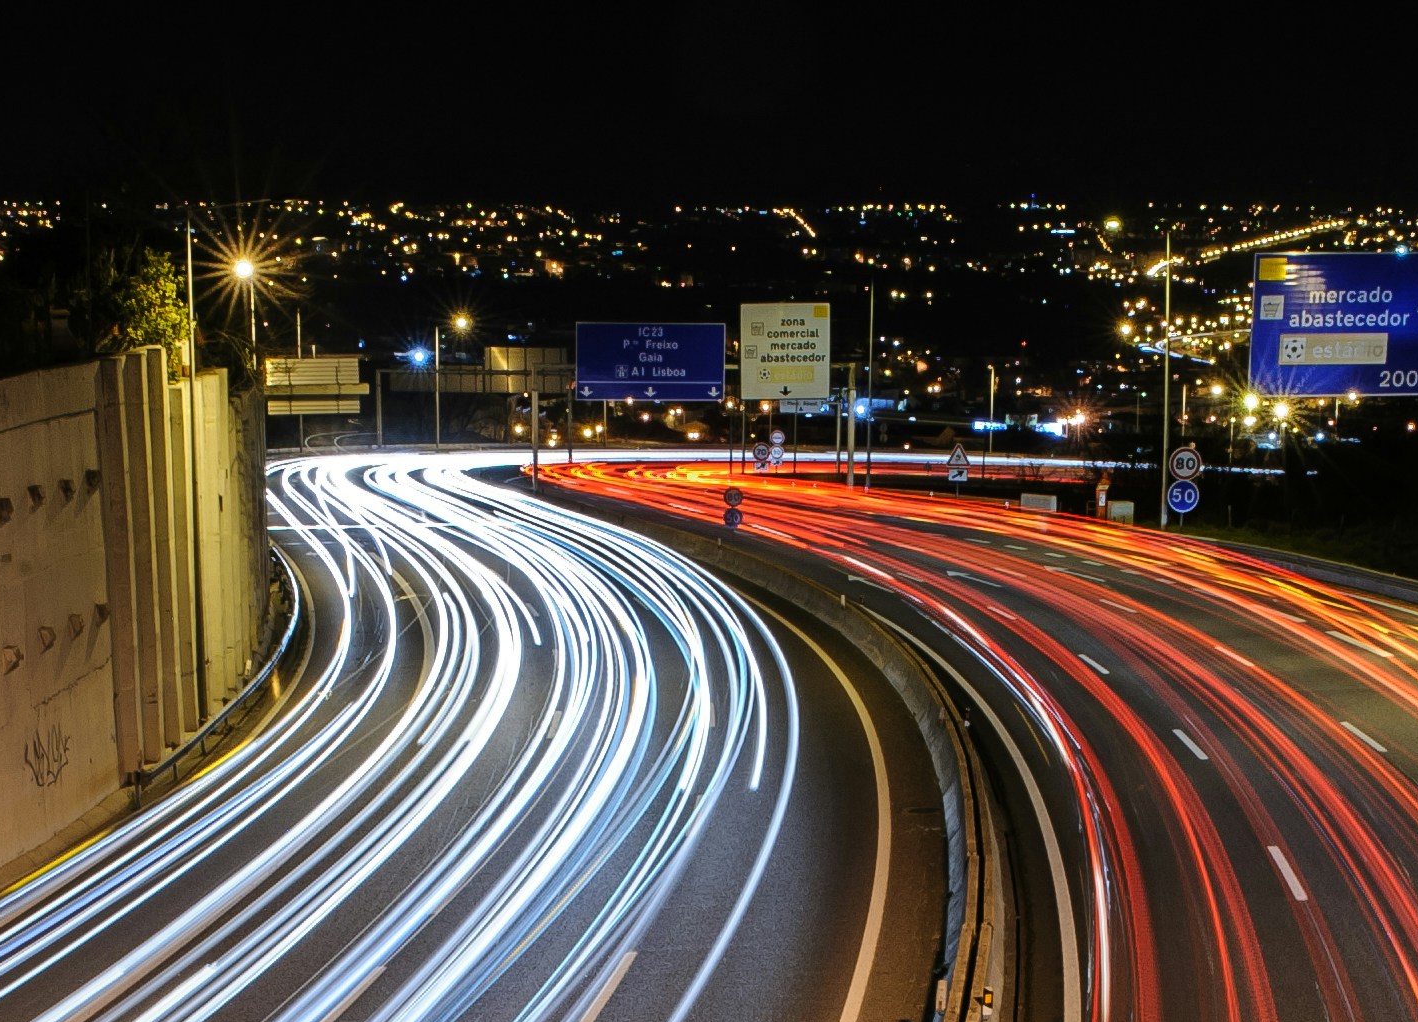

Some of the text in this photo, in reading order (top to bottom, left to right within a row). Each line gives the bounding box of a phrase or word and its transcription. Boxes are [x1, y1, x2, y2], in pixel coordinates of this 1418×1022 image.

[1309, 286, 1392, 303] mercado
[781, 319, 805, 327] zona
[1289, 310, 1410, 327] abastecedor
[638, 327, 664, 337] IC23
[767, 329, 819, 338] comercial
[645, 339, 679, 349] Freixo
[770, 341, 816, 351] mercado
[639, 352, 663, 362] Gaia
[760, 353, 826, 363] abastecedor
[652, 366, 686, 377] Lisboa
[1379, 370, 1418, 387] 200
[756, 448, 767, 456] 70
[1175, 457, 1196, 470] 80
[1171, 488, 1196, 503] 50
